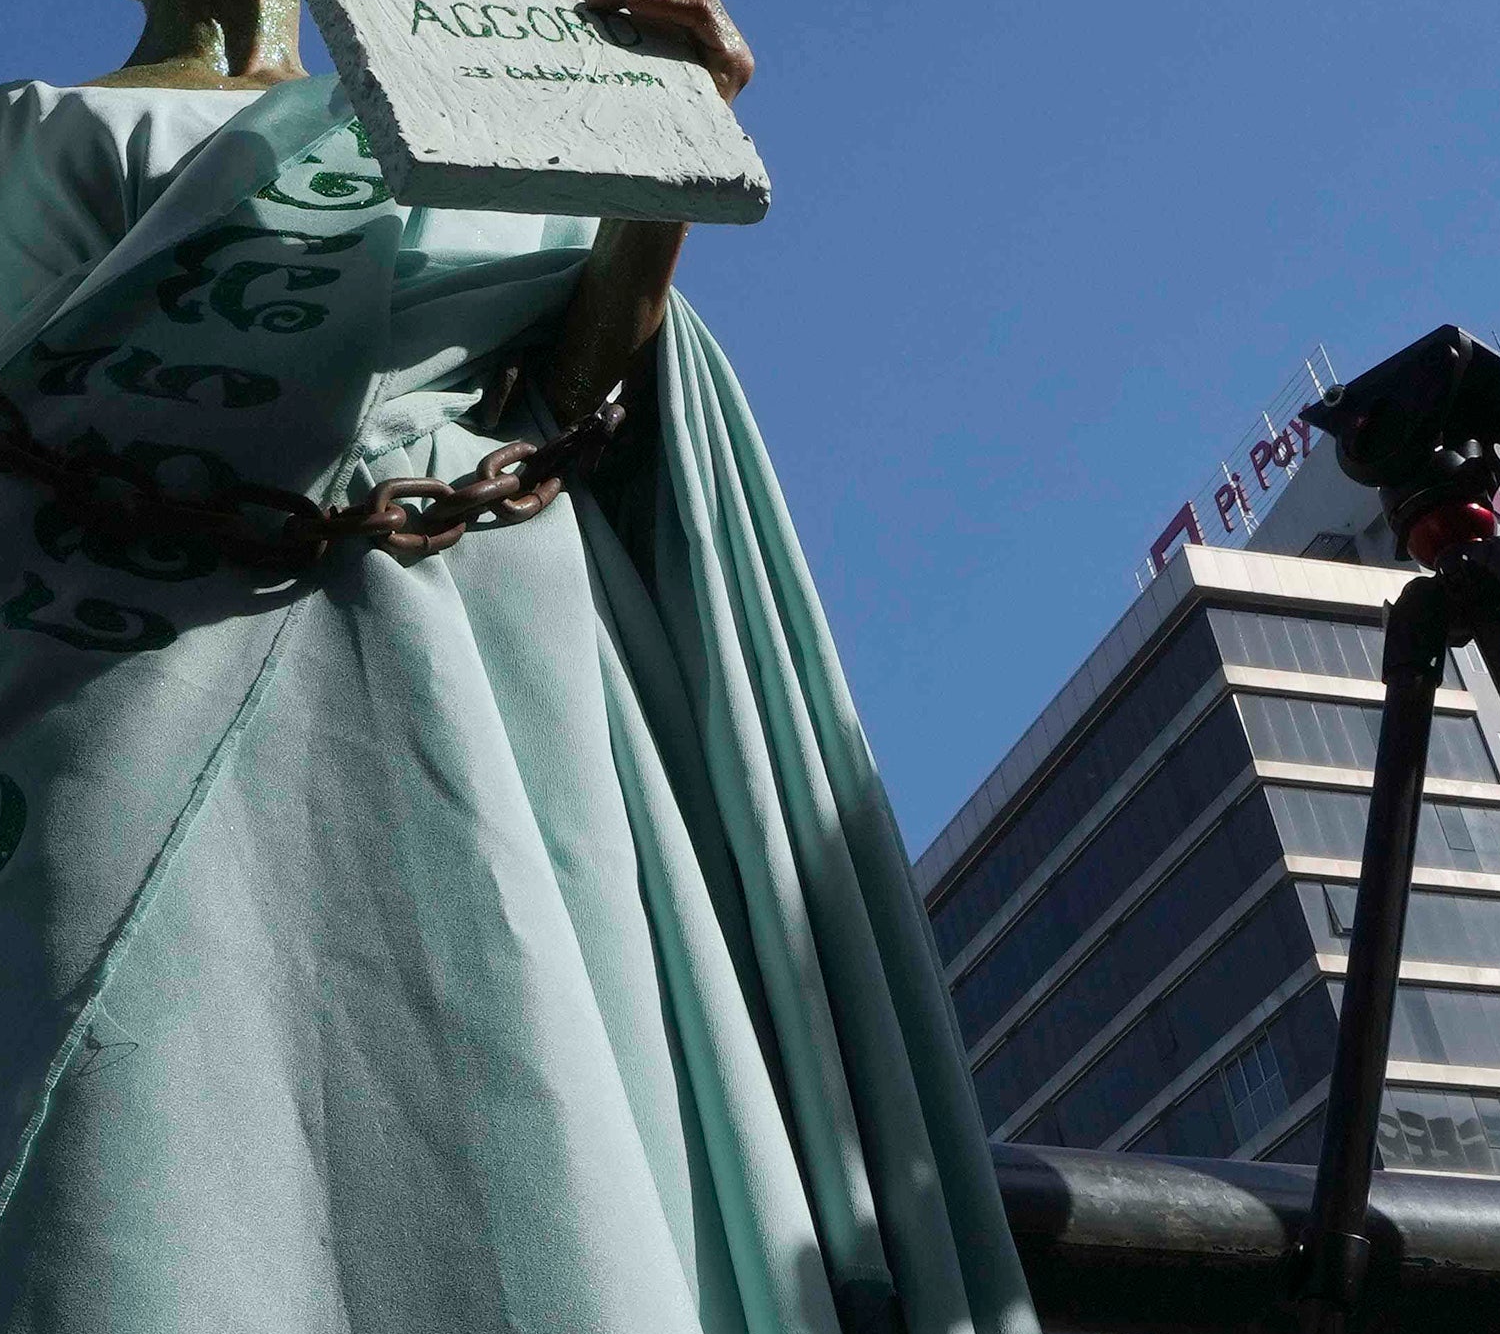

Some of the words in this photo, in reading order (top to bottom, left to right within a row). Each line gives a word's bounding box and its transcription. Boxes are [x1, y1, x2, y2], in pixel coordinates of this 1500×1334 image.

[459, 65, 494, 79] 23
[1213, 472, 1253, 534] Pi
[1249, 402, 1314, 491] Pay
